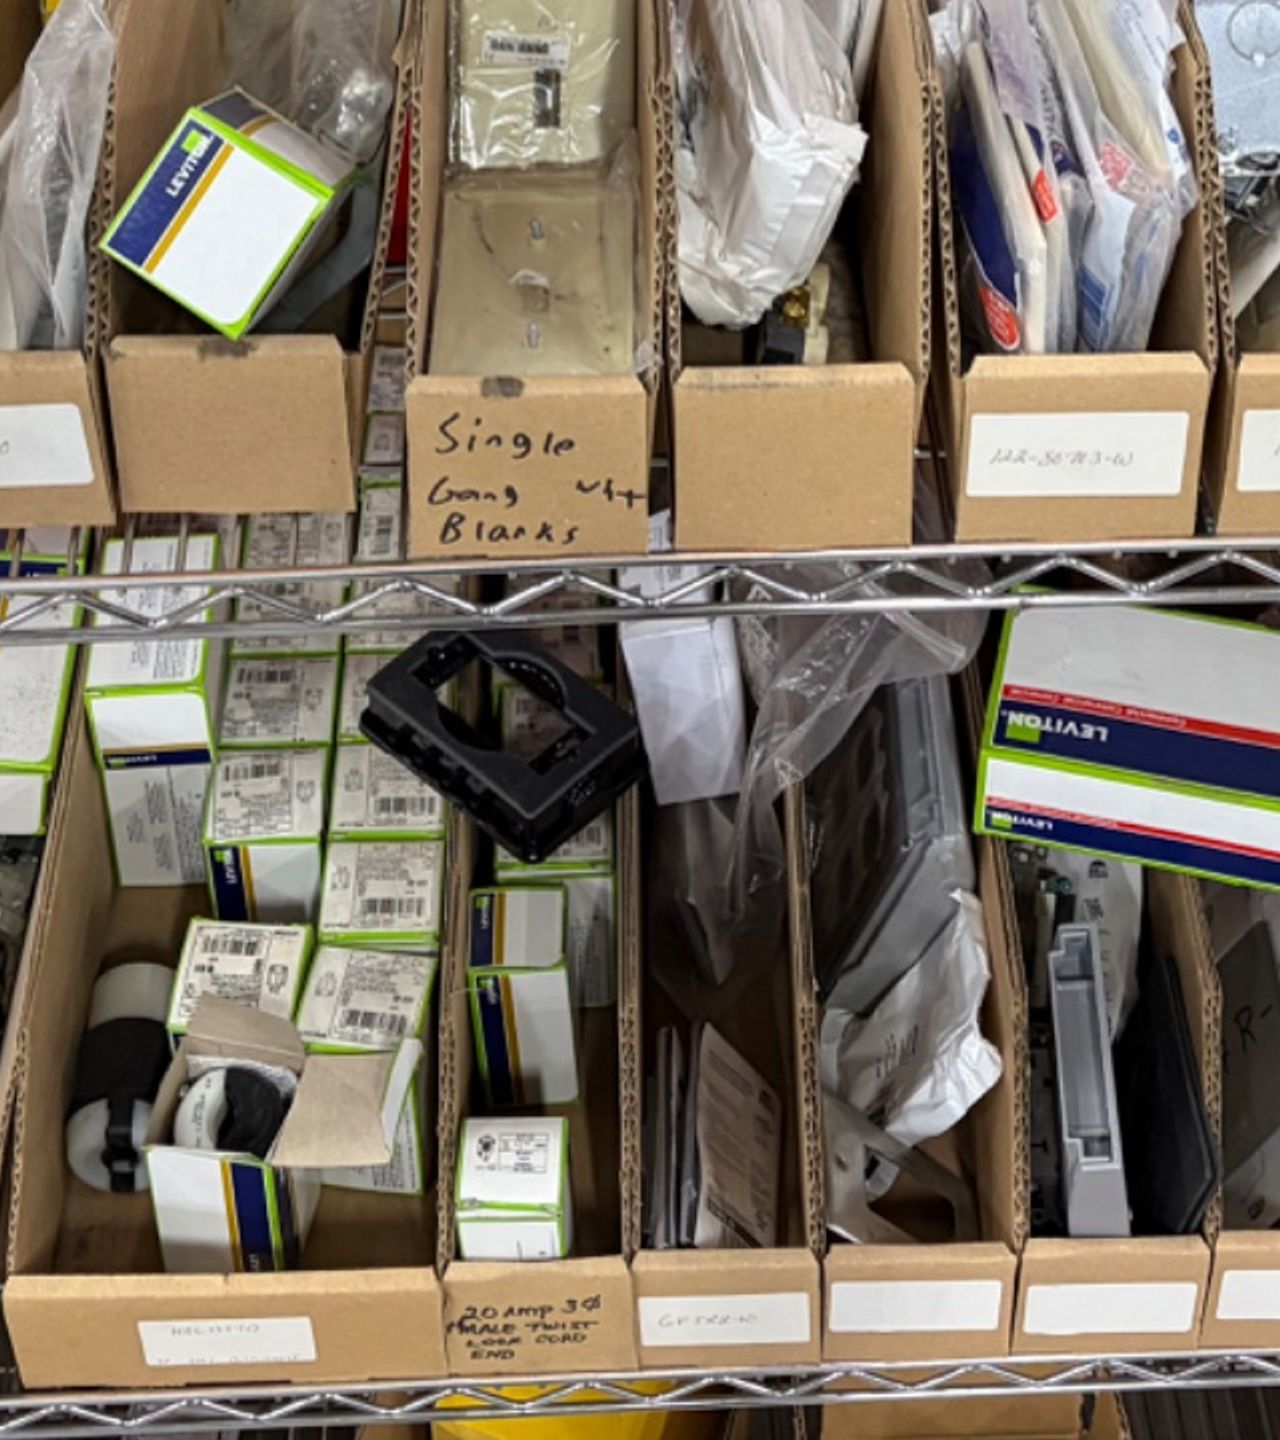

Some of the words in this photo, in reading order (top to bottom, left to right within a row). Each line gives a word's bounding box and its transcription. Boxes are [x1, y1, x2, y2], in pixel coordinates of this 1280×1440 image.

[435, 411, 576, 460] Single
[428, 475, 519, 509] Gang
[439, 511, 581, 546] Blanks
[1006, 710, 1109, 743] LEVITON
[991, 810, 1054, 831] LEVITON
[464, 1306, 498, 1322] 20
[503, 1305, 553, 1320] AMP
[470, 1348, 516, 1360] END
